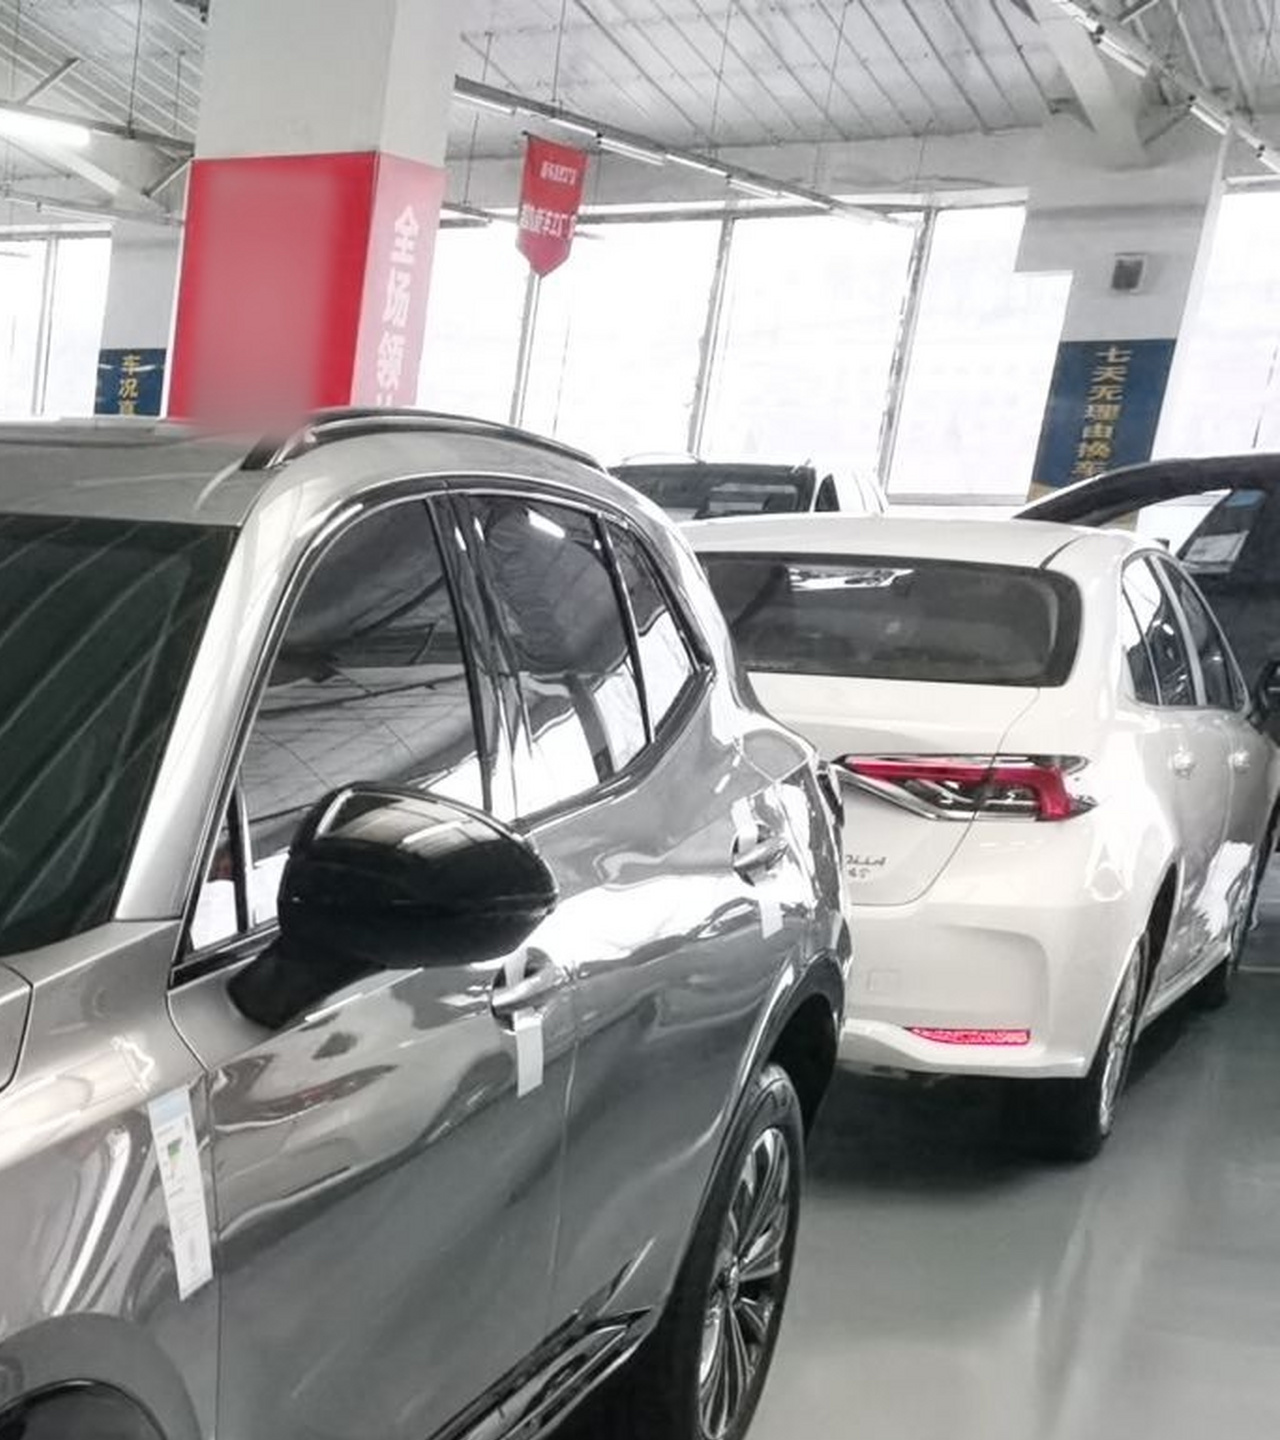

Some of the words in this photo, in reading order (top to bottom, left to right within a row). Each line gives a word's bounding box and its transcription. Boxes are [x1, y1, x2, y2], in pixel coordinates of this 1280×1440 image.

[376, 204, 420, 407] 全场领
[1071, 346, 1133, 478] 七天无理由换车
